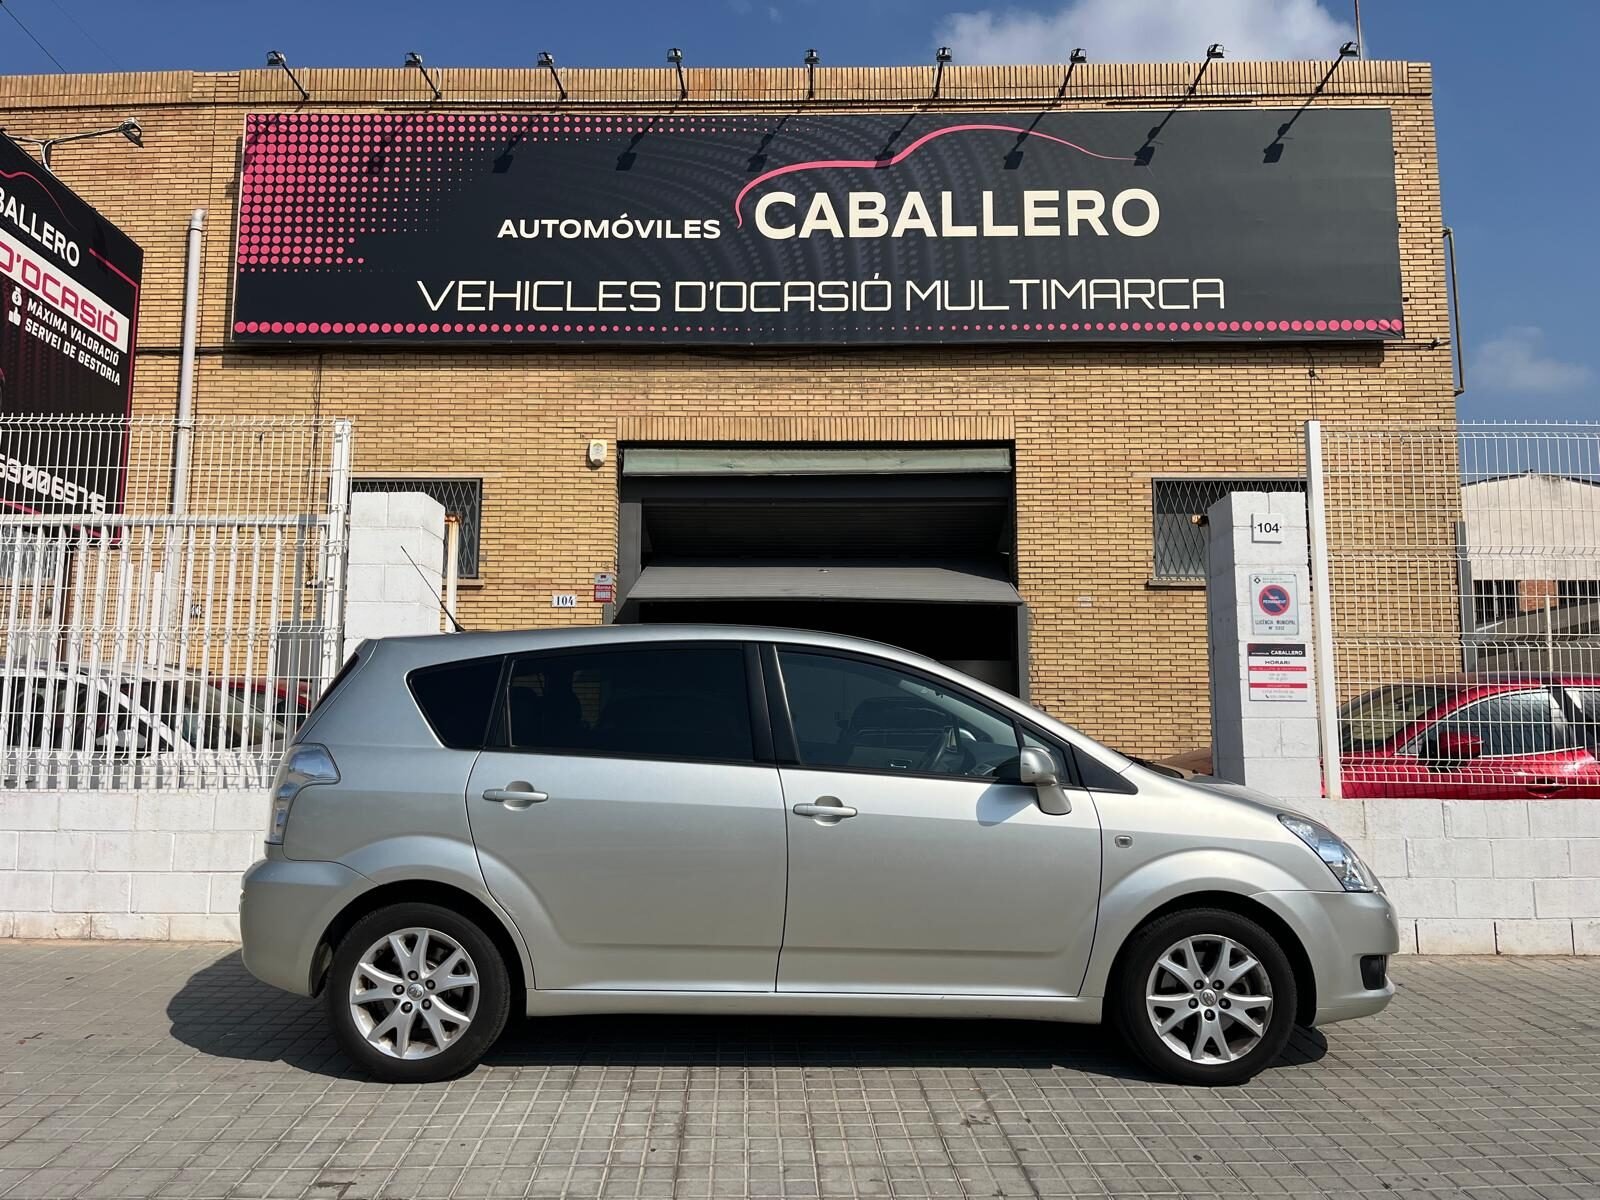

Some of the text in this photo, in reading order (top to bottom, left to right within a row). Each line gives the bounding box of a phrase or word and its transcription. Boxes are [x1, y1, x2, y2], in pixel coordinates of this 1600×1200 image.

[497, 188, 1161, 240] AUTOMÓVILES CABALLERO
[416, 272, 1226, 313] VEHICLES D'OCASIÓ MULTIMARCA
[24, 317, 121, 387] SERVEI DE GESTORIA
[27, 297, 120, 367] MÀXIMA VALORACIÓ
[1257, 522, 1280, 534] 104
[556, 596, 573, 606] 104
